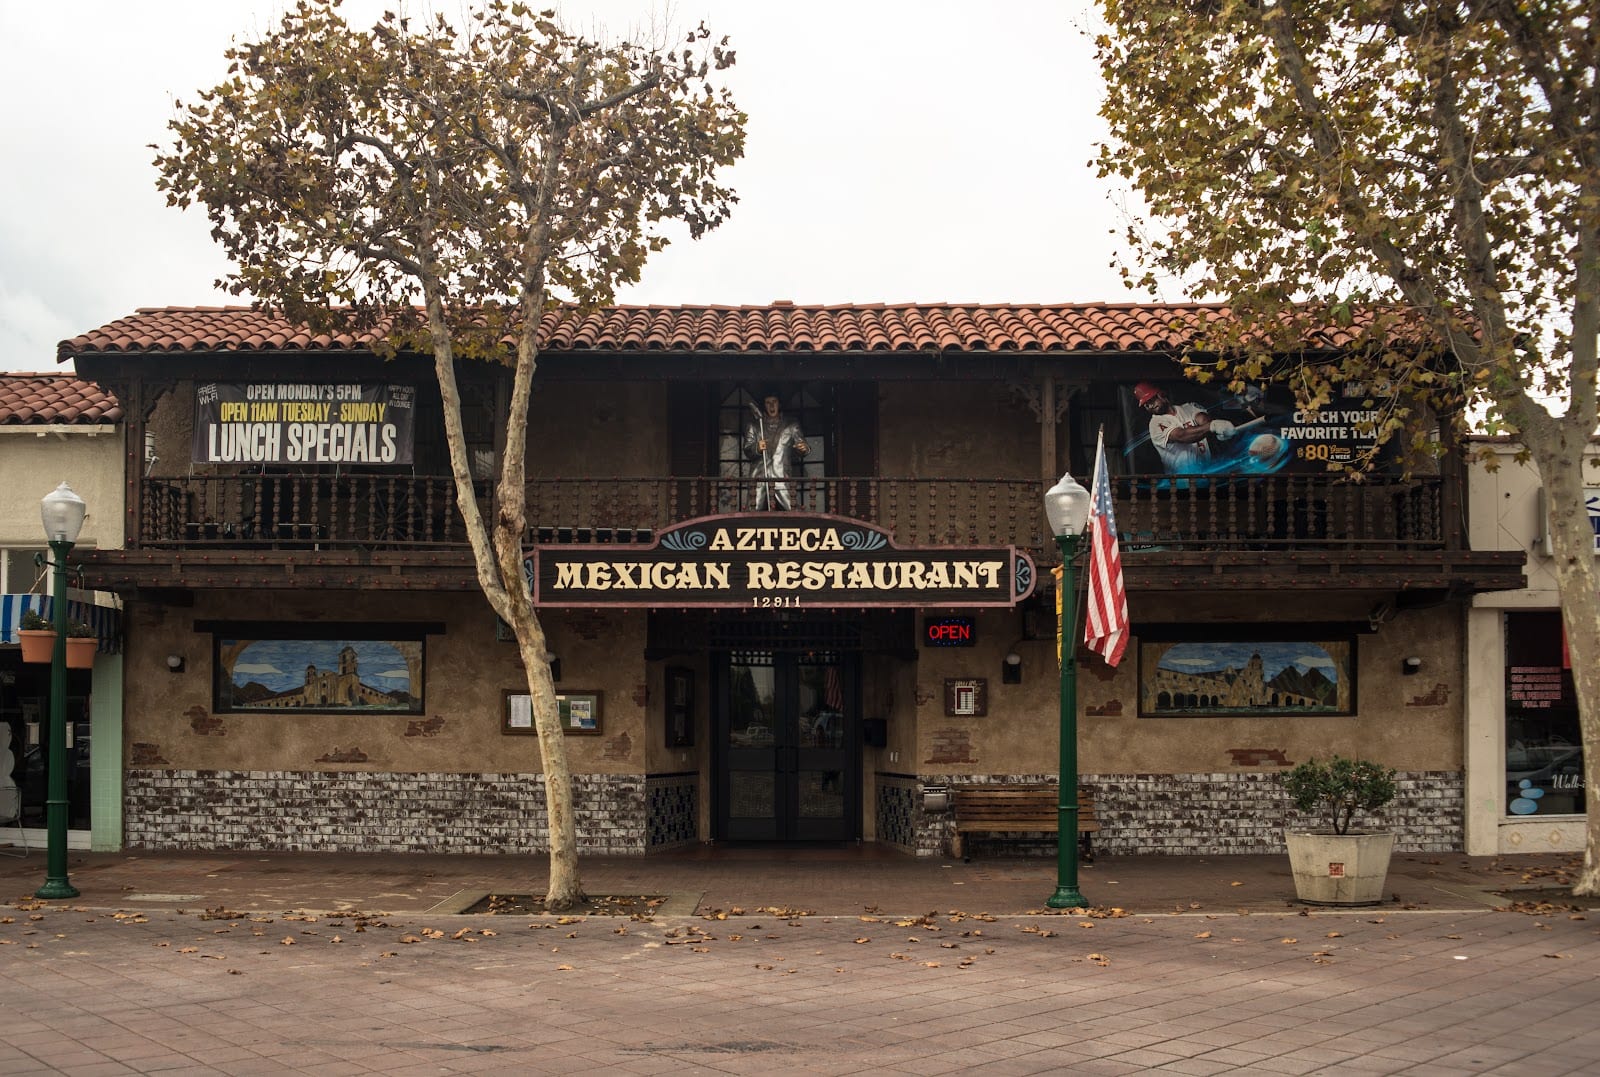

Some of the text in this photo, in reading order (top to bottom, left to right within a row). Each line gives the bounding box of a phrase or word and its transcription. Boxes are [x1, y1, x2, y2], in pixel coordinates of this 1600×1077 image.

[198, 383, 217, 395] FREE
[247, 384, 362, 400] OPEN MONDAY'S 5PM
[199, 392, 218, 405] WI-FI
[220, 402, 248, 422] OPEN
[250, 402, 278, 422] 11AM
[282, 402, 330, 422] TUESDAY
[340, 402, 386, 422] SUNDAY
[1280, 427, 1348, 440] FAVORITE
[208, 423, 397, 463] LUNCH SPECIALS
[1305, 444, 1329, 460] 80
[708, 527, 844, 551] AZTECA
[552, 560, 1002, 590] MEXICAN RESTAURANT
[751, 597, 802, 608] 12911
[928, 625, 970, 640] OPEN
